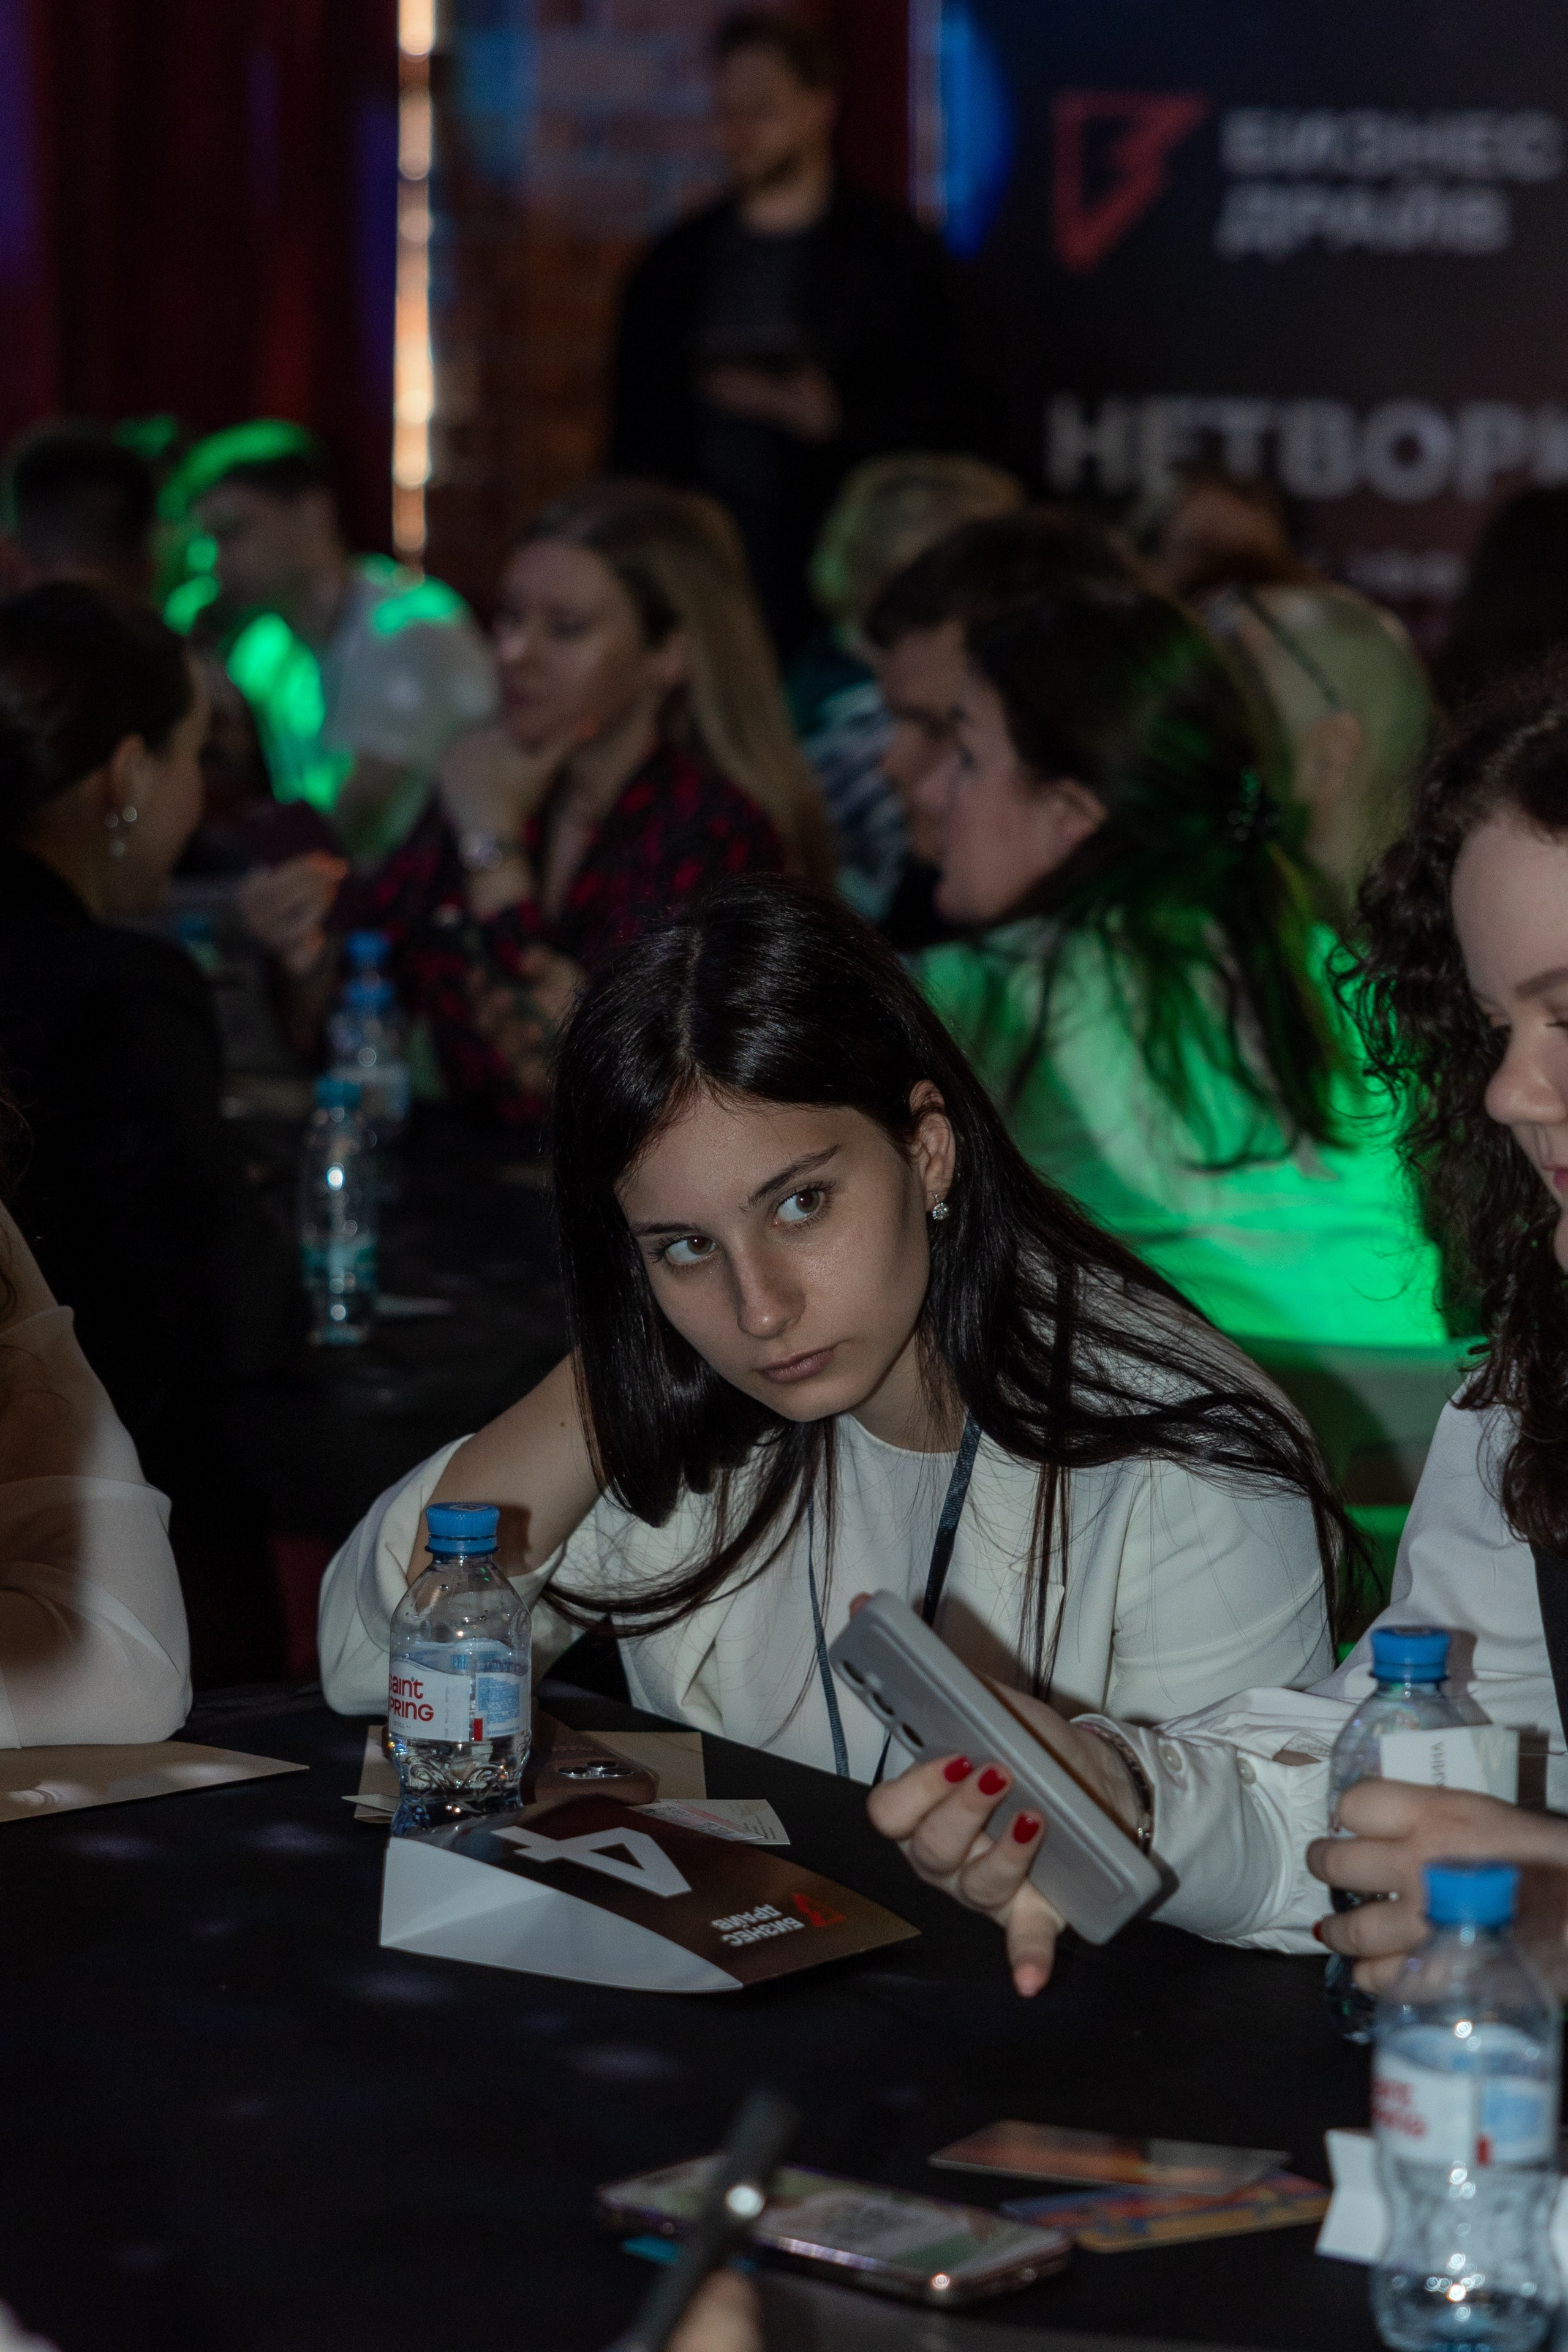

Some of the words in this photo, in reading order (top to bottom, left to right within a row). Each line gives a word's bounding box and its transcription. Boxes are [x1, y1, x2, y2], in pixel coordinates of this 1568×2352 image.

[491, 1825, 693, 1898] 4
[710, 1903, 783, 1931] ДРАЙВ
[720, 1917, 805, 1947] БИЗНЕС
